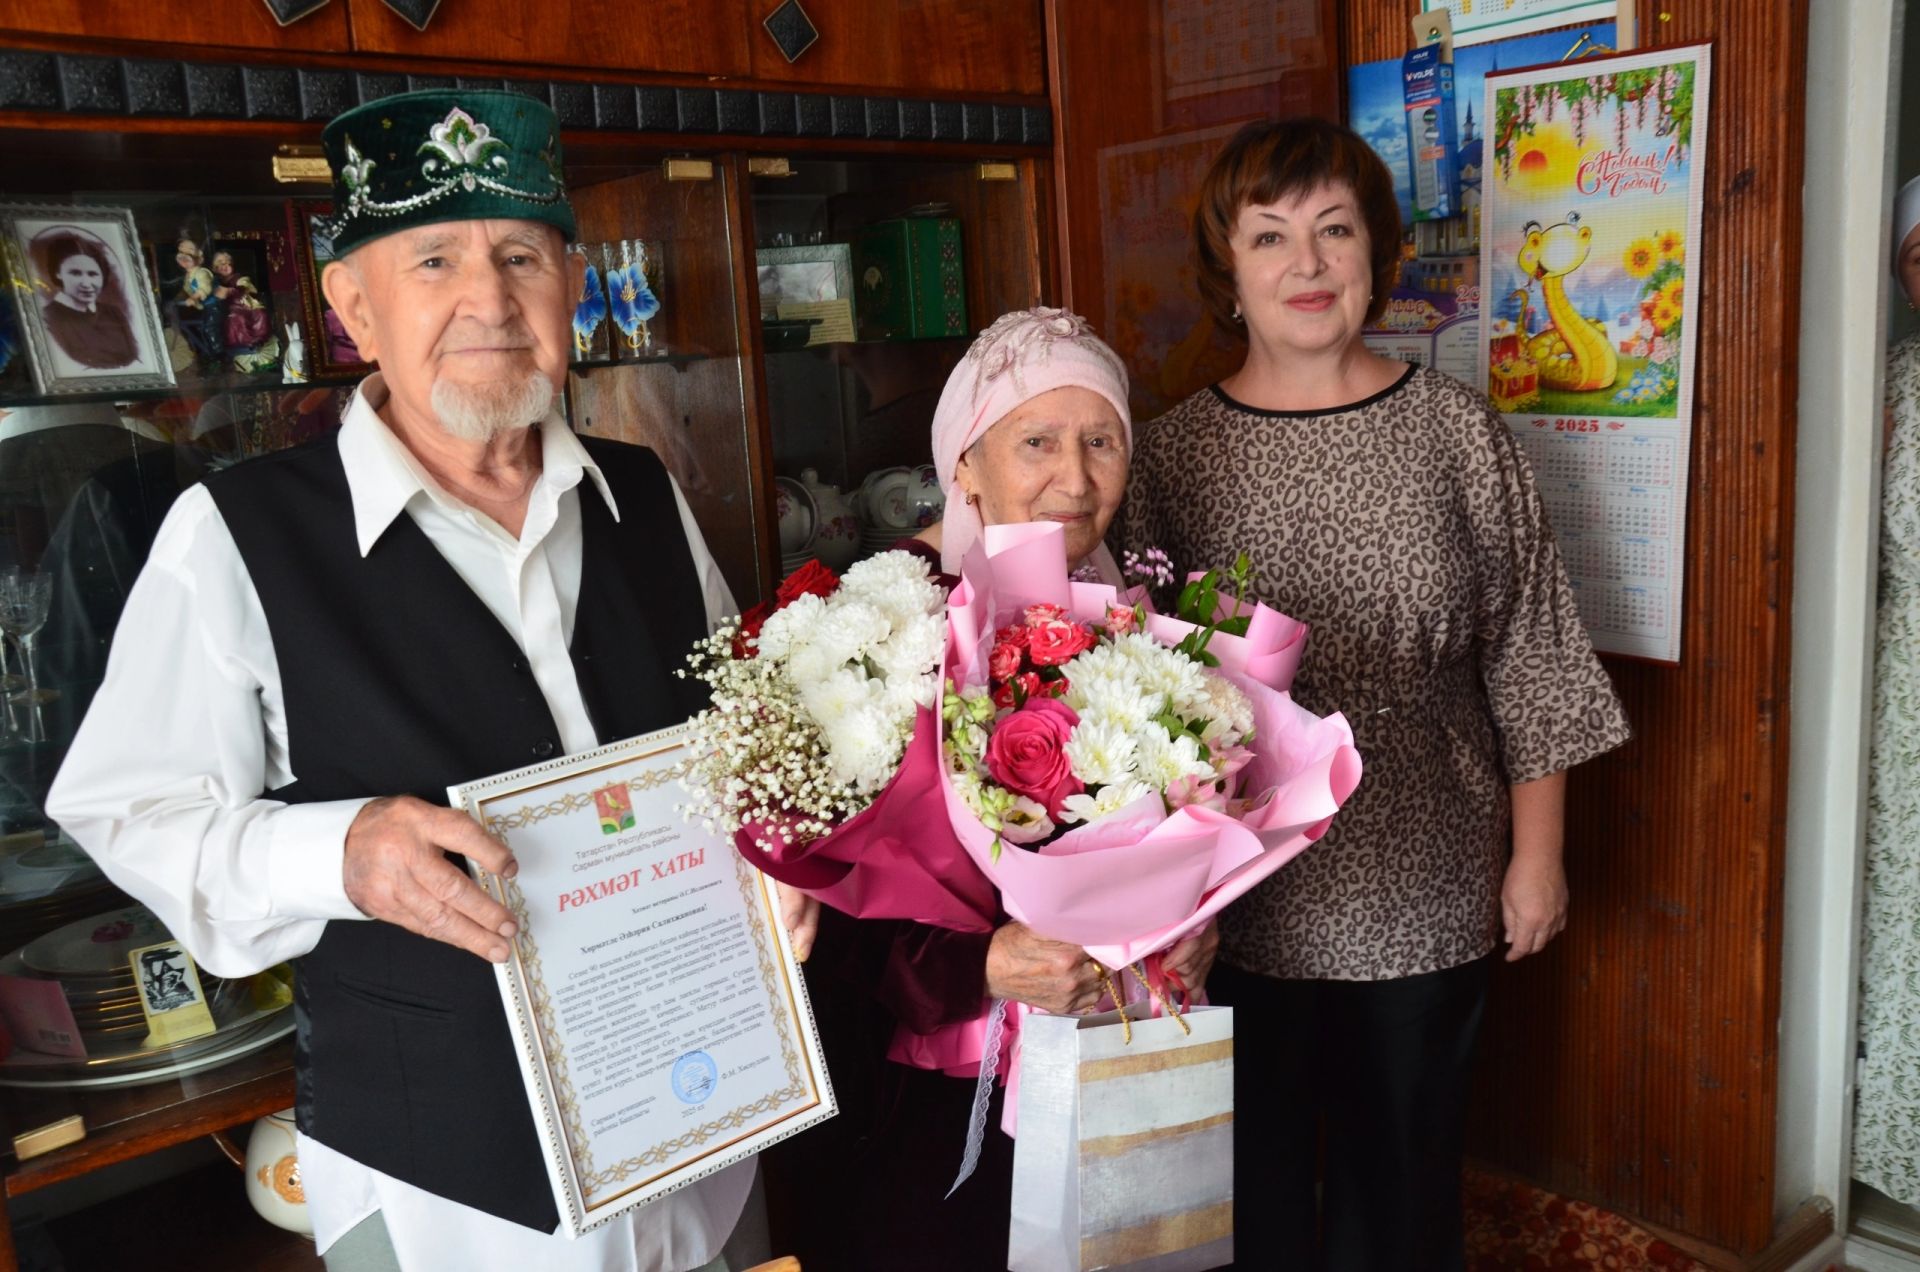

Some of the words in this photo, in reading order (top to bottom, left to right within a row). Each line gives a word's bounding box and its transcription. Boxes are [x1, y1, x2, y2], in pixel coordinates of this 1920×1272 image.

[1555, 419, 1600, 432] 2025
[572, 858, 603, 873] Сарман
[604, 843, 651, 862] муниципаль
[651, 833, 681, 848] районы
[575, 843, 616, 859] Татарстан
[616, 824, 672, 846] Республикасы
[558, 869, 641, 912] РӘХМӘТ
[651, 847, 704, 881] ХАТЫ
